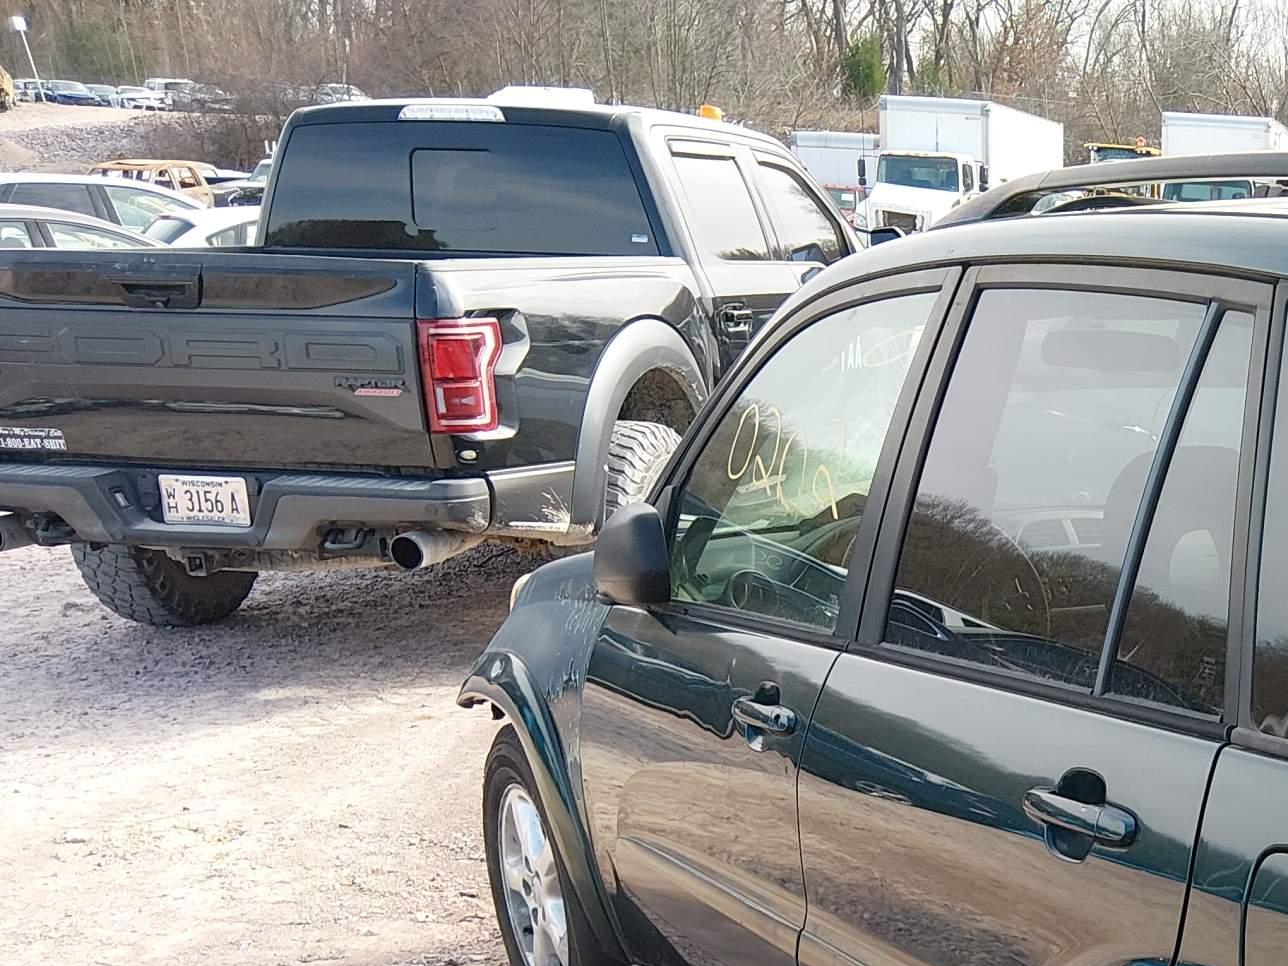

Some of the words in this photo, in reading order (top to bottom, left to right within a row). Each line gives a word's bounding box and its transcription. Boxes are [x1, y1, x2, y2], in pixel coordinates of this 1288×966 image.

[181, 479, 223, 488] WISCONSIN
[184, 489, 224, 513] 3156
[230, 491, 241, 514] A
